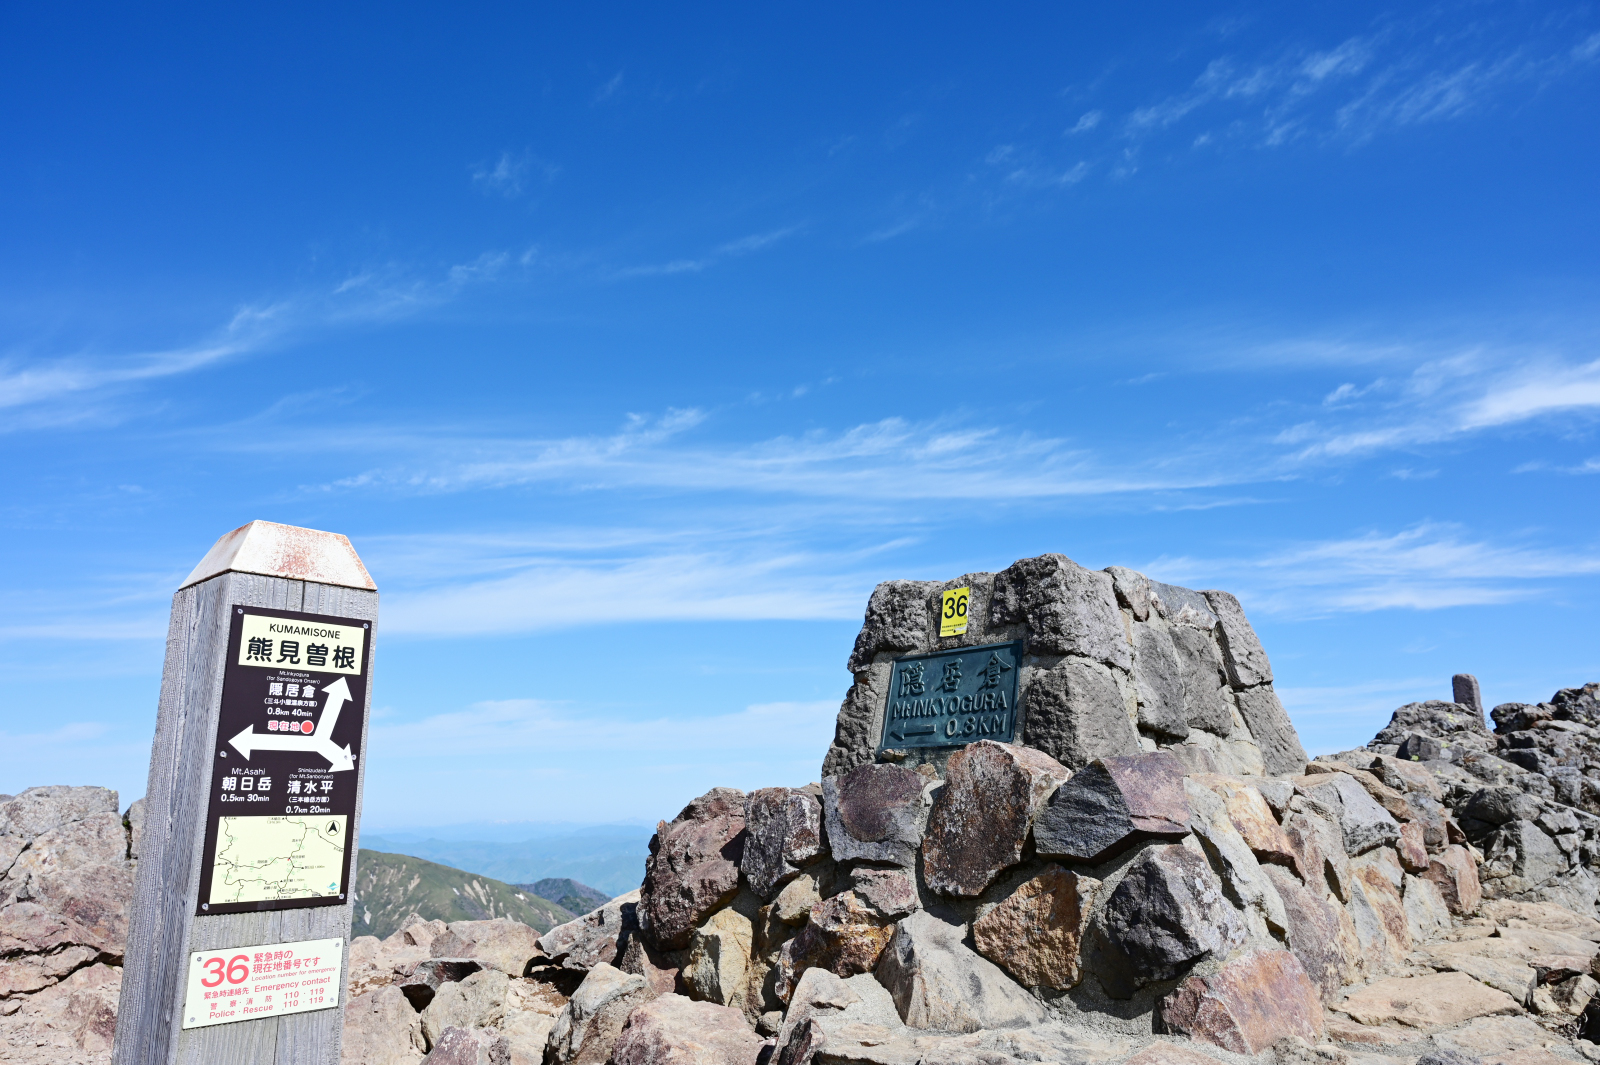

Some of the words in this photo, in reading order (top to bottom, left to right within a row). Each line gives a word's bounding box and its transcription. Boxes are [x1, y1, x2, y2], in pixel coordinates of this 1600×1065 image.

[944, 595, 968, 619] 36
[269, 623, 341, 640] KUMAMISONE
[246, 636, 355, 670] 熊見曽根
[268, 682, 316, 698] 隠居倉
[267, 707, 290, 716] 0.8km
[291, 708, 313, 717] 40min
[267, 720, 300, 732] 現在地
[946, 713, 1008, 738] 0.8KM
[231, 767, 266, 776] Mt.Asahi
[221, 776, 272, 791] 朝日岳
[286, 780, 334, 794] 清水平
[220, 793, 245, 802] 0.5km
[246, 793, 270, 802] 30min
[285, 805, 308, 814] 0.7km
[309, 805, 331, 814] 20min
[253, 950, 294, 963] 緊急時の
[201, 954, 250, 988] 36
[252, 956, 321, 974] 現在地番号です
[251, 974, 276, 982] Location
[254, 981, 300, 993] Emergency
[301, 976, 331, 986] contact
[204, 987, 249, 1000] 緊急時連絡先
[284, 991, 300, 999] 110
[310, 987, 325, 996] 119
[283, 999, 299, 1008] 110
[308, 996, 324, 1004] 119
[209, 1010, 236, 1019] Police
[242, 1005, 274, 1014] Rescue
